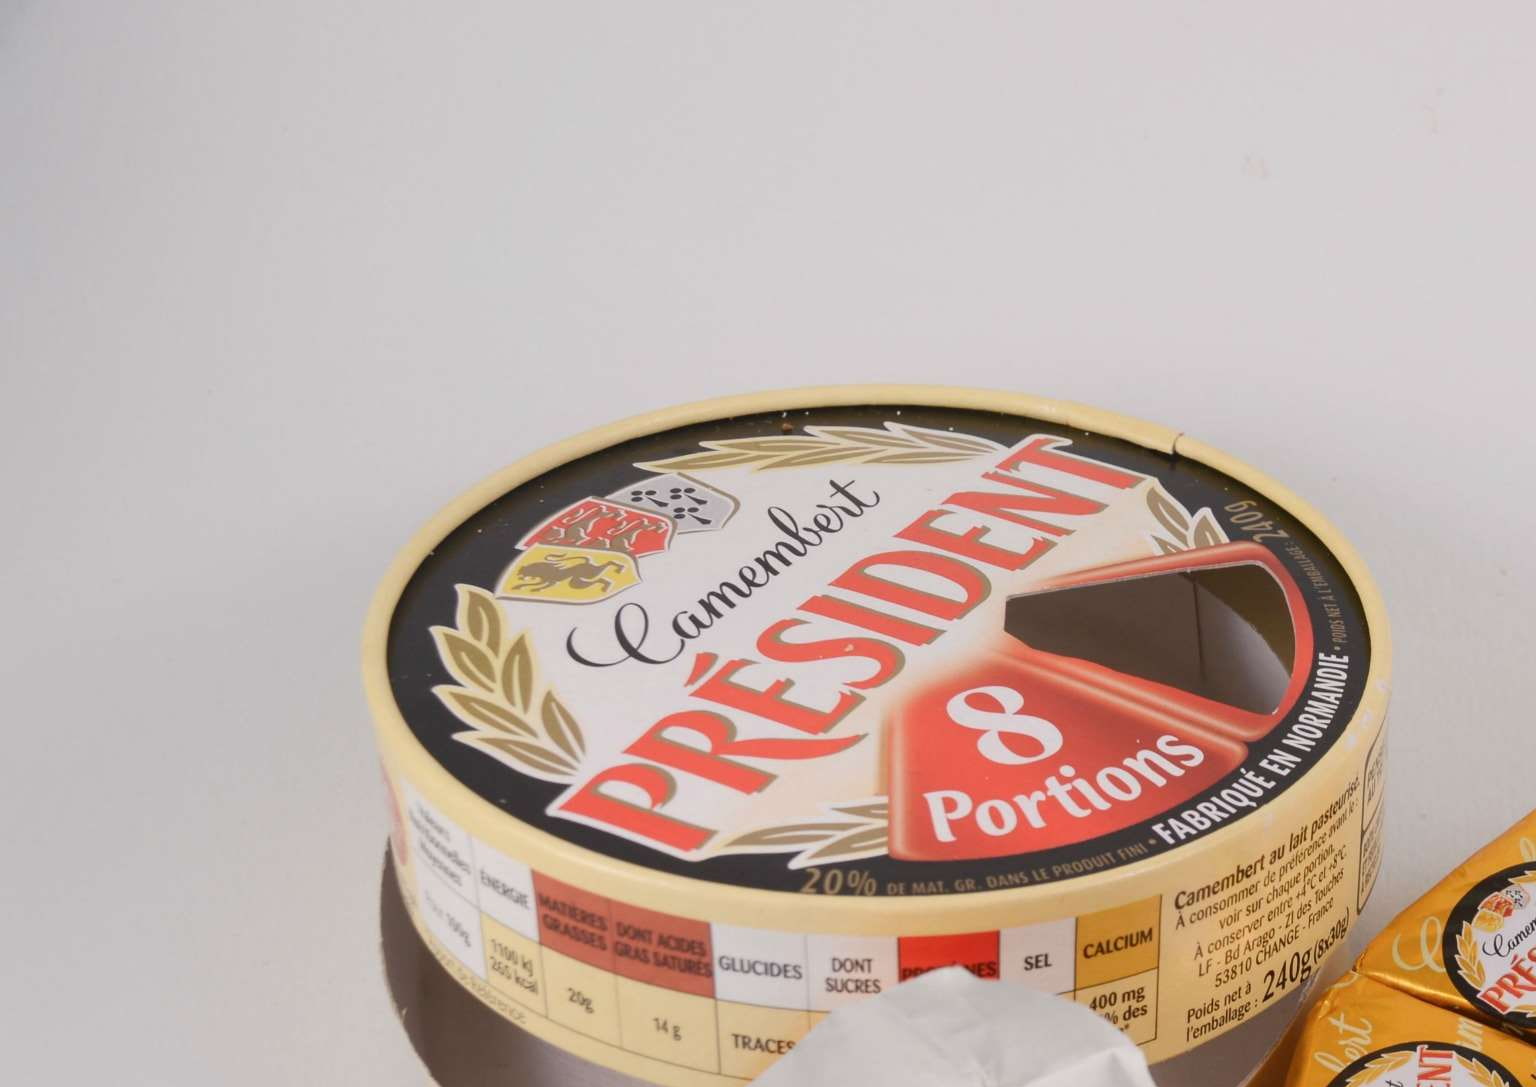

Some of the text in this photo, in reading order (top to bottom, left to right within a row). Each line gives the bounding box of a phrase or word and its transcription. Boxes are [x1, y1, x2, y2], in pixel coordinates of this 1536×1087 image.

[1224, 500, 1290, 543] 240g
[566, 479, 881, 668] Camembert
[1323, 602, 1341, 618] NET
[1329, 618, 1348, 644] POIDS
[553, 436, 1148, 854] PRÉSIDENT
[946, 685, 1063, 765] 8
[1151, 651, 1350, 846] FABRIQUÉ EN NORMANDIE
[922, 734, 1206, 843] Portions
[801, 842, 1149, 897] 20% DE MAT. GR. DANS LE PRODUIT FINI
[1174, 858, 1265, 911] Camembert
[1269, 846, 1286, 866] au
[1288, 825, 1309, 854] lait
[1175, 910, 1187, 931] À
[1189, 879, 1261, 924] consommer
[1263, 869, 1276, 887] de
[1198, 867, 1345, 978] LF Bd Arago ZI des Touches
[1218, 909, 1244, 930] voir
[1244, 896, 1266, 917] sur
[1265, 874, 1302, 906] chaque
[1082, 927, 1154, 961] CALCIUM
[1193, 941, 1204, 961] À
[1206, 914, 1266, 956] conserver
[1266, 896, 1294, 925] entre
[1214, 896, 1335, 989] 53810 CHANGE France
[718, 954, 804, 981] GLUCIDES
[824, 977, 882, 994] SUCRES
[831, 957, 874, 974] DONT
[1023, 953, 1053, 972] SEL
[1089, 985, 1146, 1011] 400 mg
[1121, 1003, 1148, 1023] des
[1185, 997, 1252, 1043] l'emballage
[1262, 948, 1313, 1004] 240g
[1186, 997, 1221, 1024] Poids
[1223, 989, 1243, 1008] net
[653, 1017, 669, 1034] 14
